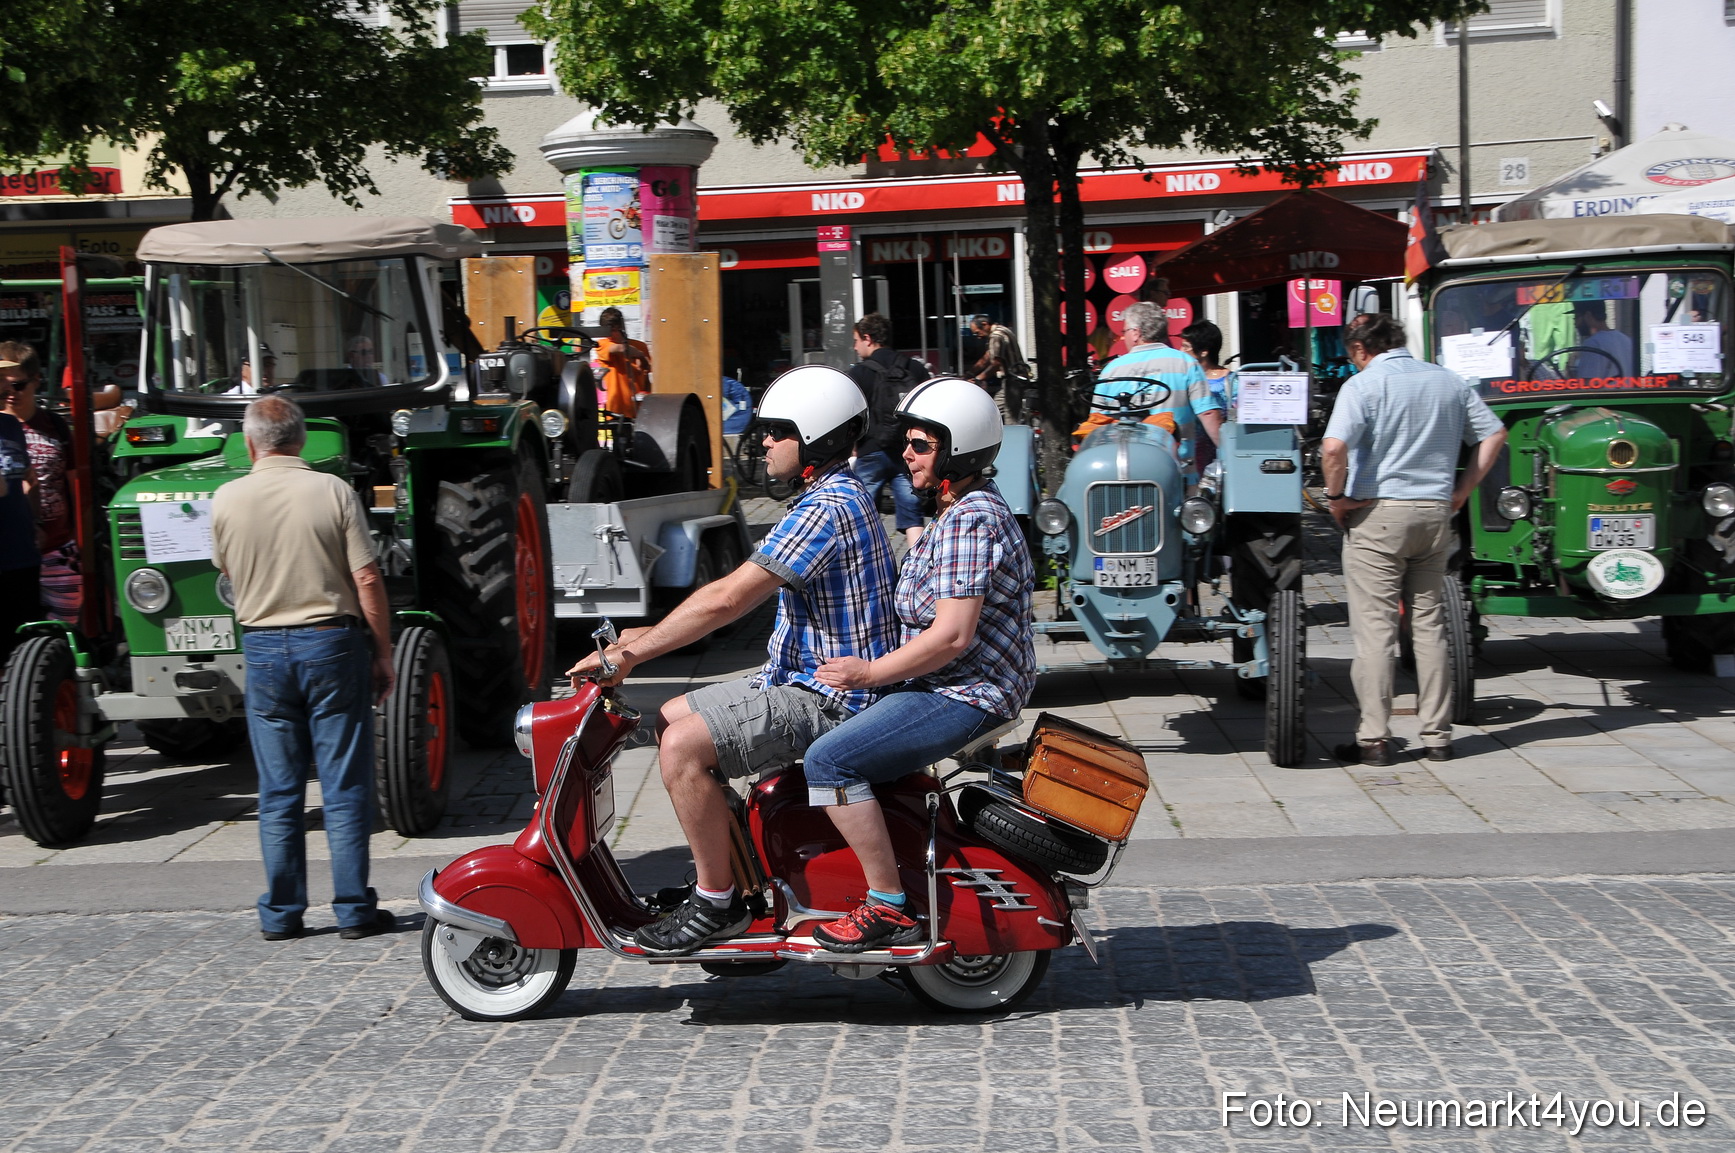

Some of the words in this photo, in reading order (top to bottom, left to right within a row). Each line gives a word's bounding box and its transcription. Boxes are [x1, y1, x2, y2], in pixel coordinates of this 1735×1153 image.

[1337, 162, 1393, 182] NKD
[1503, 164, 1526, 181] 28
[1166, 173, 1221, 192] NKD
[811, 192, 865, 211] NKD
[482, 205, 536, 223] NKD
[79, 239, 120, 254] Foto
[872, 240, 931, 262] NKD
[946, 237, 1005, 258] NKD
[1289, 251, 1339, 270] NKD
[1109, 266, 1140, 278] SALE
[0, 308, 48, 319] BILDER
[1682, 333, 1705, 344] 548
[1268, 384, 1292, 395] 569
[136, 491, 215, 502] DEUT
[1117, 559, 1138, 572] NM
[1100, 573, 1119, 586] PX
[1124, 573, 1152, 586] 122
[183, 618, 215, 634] NM
[170, 634, 198, 650] VH
[211, 633, 232, 649] 21
